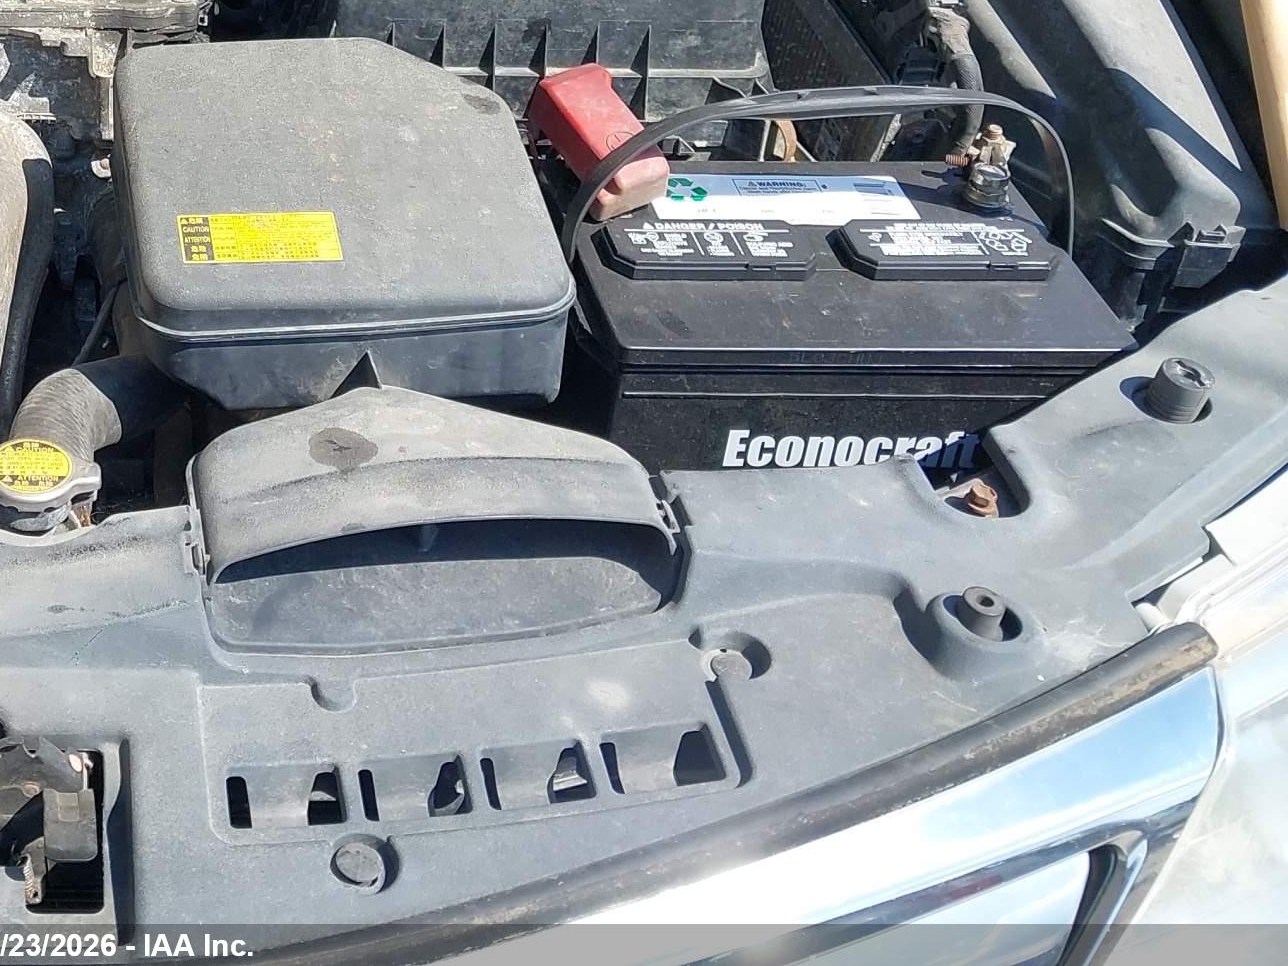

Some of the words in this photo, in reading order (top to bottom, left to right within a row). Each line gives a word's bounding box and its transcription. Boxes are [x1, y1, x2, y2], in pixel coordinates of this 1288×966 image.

[654, 222, 705, 230] DANGER
[717, 222, 764, 230] POISON
[722, 429, 981, 468] Econocraft
